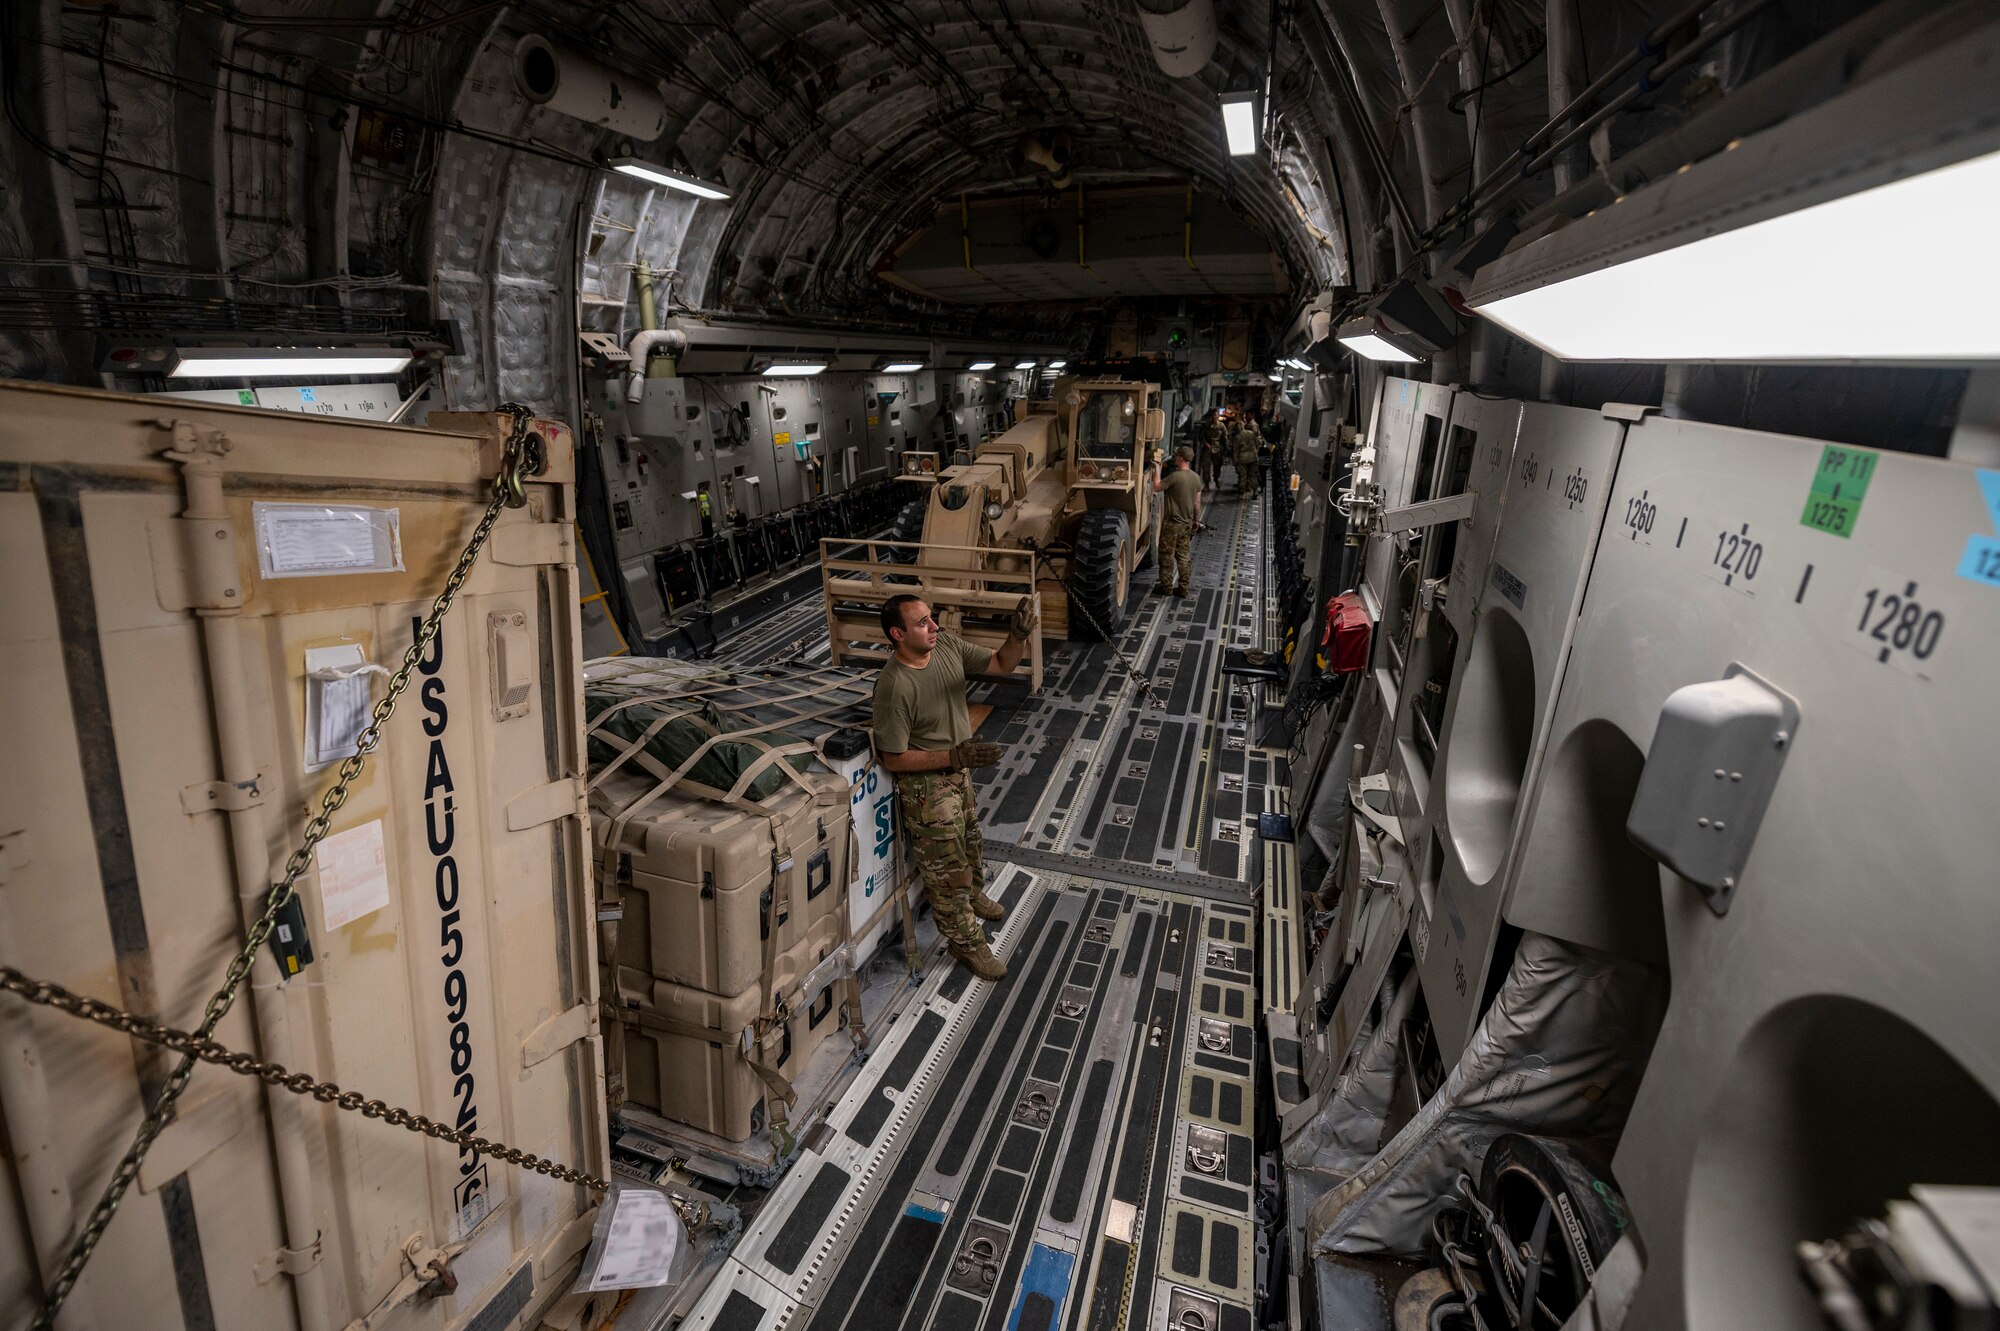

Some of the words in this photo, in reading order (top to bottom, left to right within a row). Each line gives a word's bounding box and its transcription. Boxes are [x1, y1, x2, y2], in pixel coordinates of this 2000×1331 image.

[1822, 450, 1847, 474] PP
[1848, 456, 1871, 481] 11
[1564, 474, 1588, 504] 1250
[1624, 497, 1657, 535] 1260
[1810, 502, 1849, 532] 1275
[1713, 530, 1763, 581] 1270
[1857, 588, 1945, 661] 1280
[1560, 1196, 1577, 1233] CABLE
[1575, 1236, 1594, 1276] SHORT
